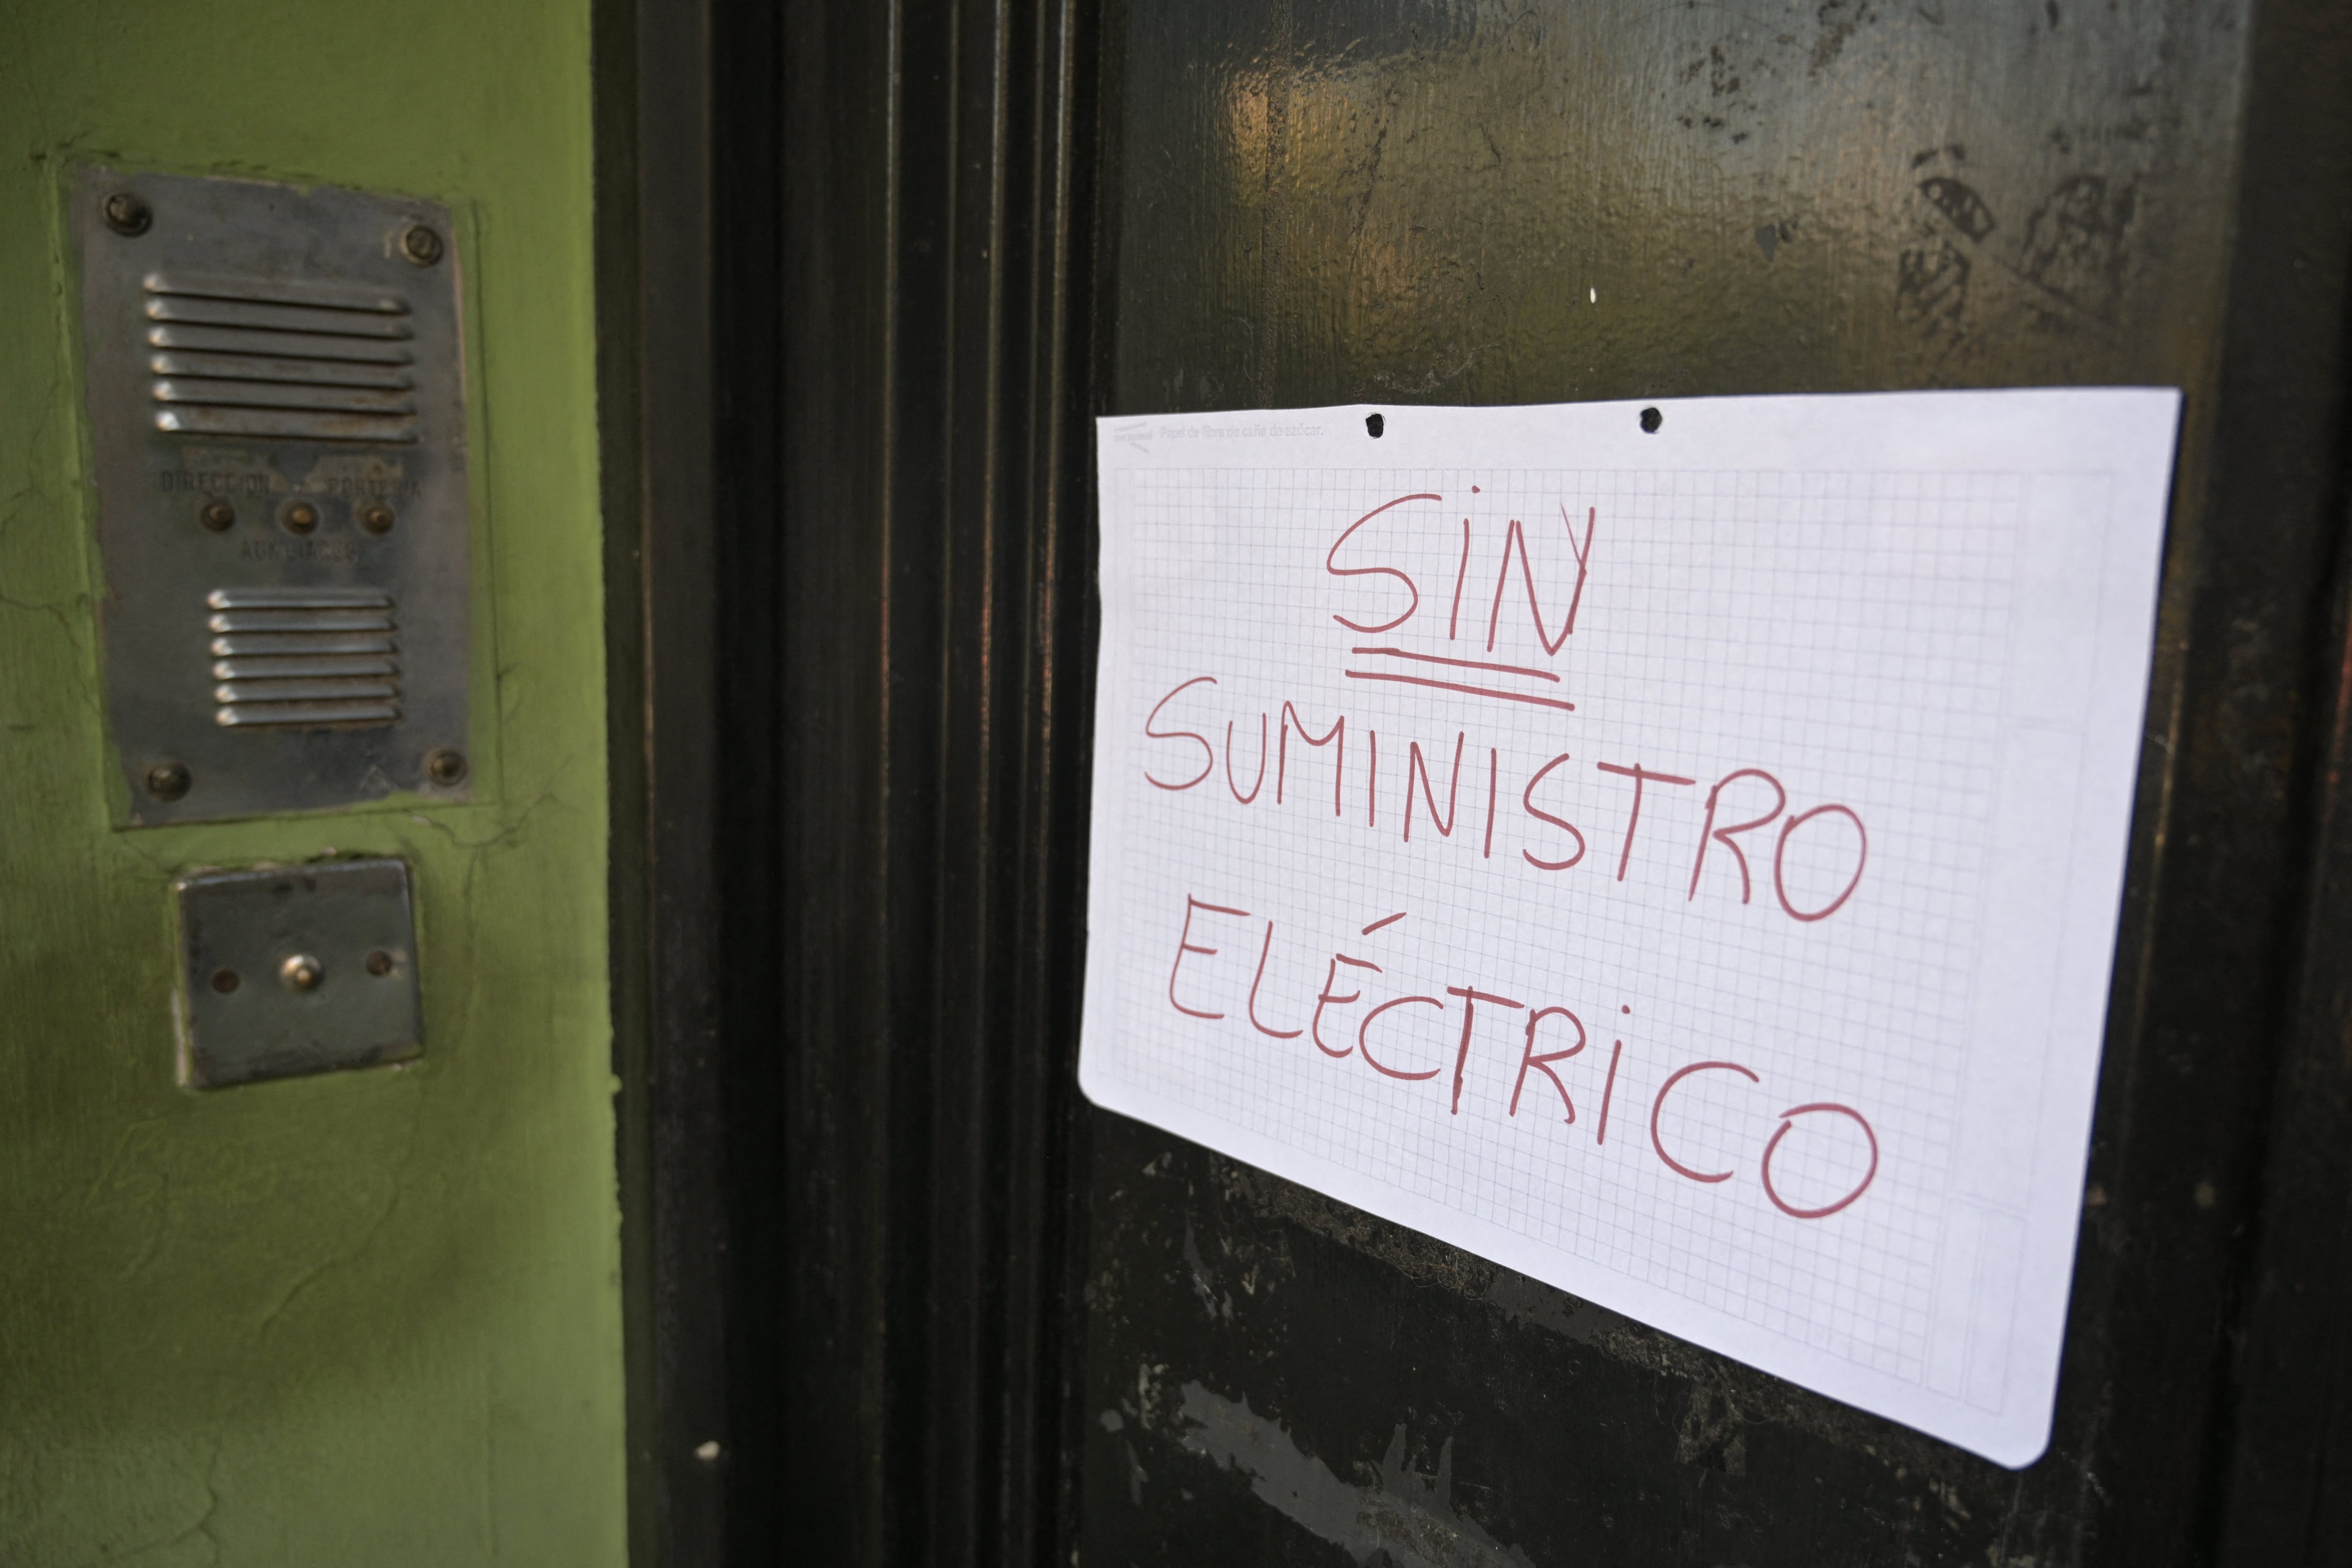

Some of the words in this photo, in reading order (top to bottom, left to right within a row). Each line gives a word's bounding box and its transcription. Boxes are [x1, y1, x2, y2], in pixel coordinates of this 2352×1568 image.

[1160, 425, 1185, 442] Papel
[1187, 425, 1200, 438] de
[1226, 425, 1240, 437] de
[1242, 424, 1266, 437] caña
[1269, 424, 1283, 437] de
[1145, 676, 1868, 923] SUMINISTRO
